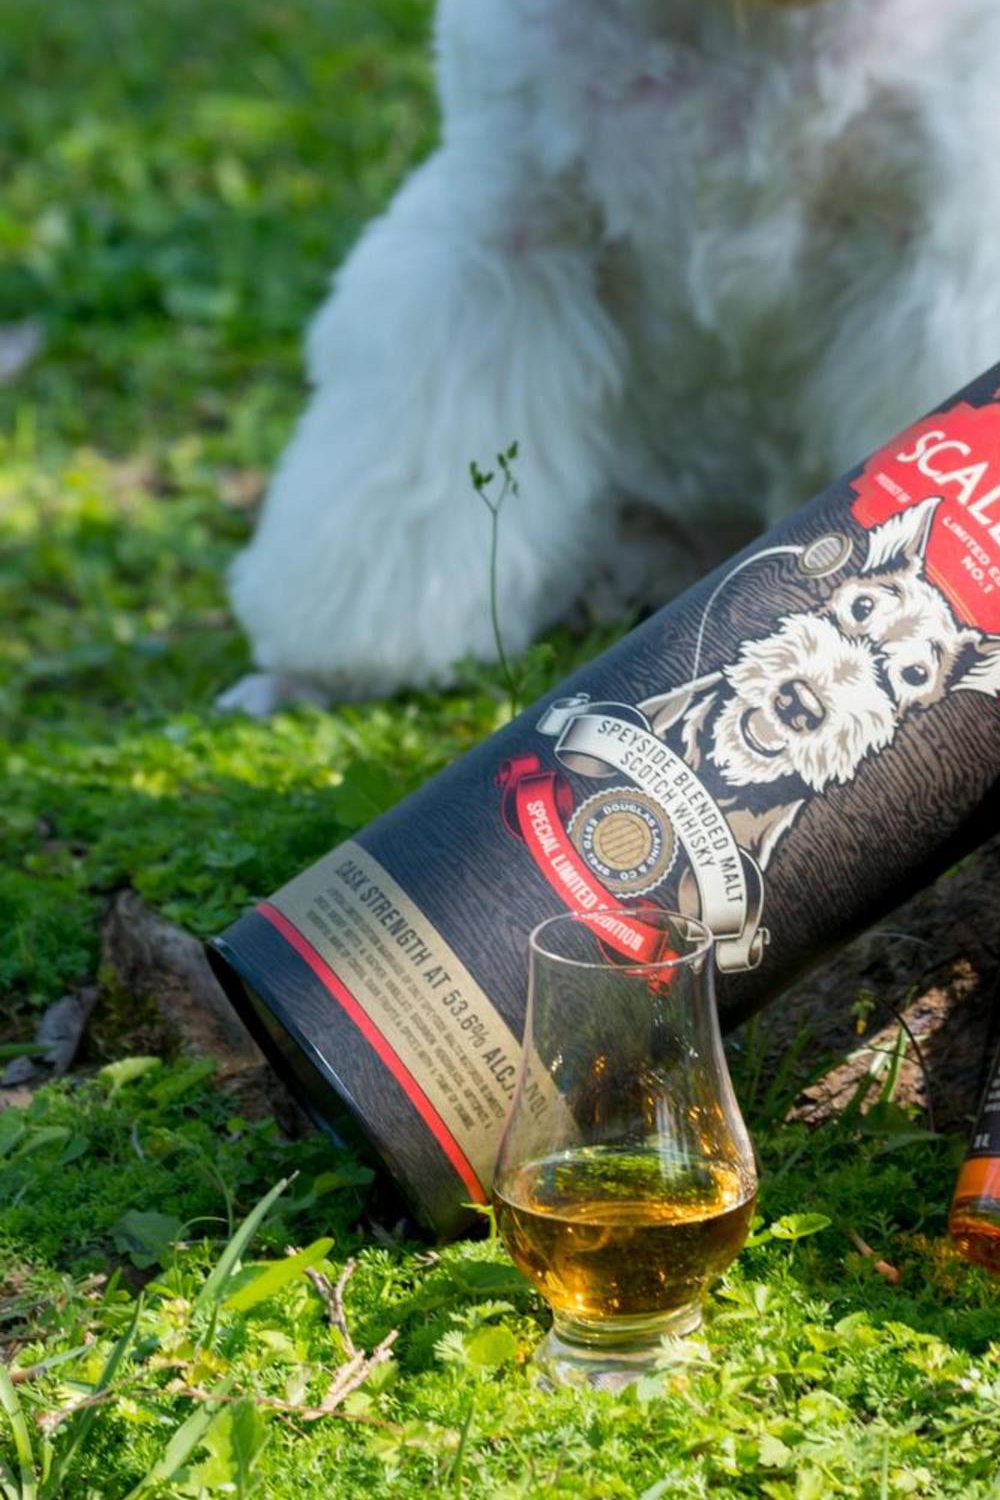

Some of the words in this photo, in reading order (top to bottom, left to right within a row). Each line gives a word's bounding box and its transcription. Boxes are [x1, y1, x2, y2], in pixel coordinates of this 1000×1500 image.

[942, 516, 991, 568] LIMITED
[960, 556, 994, 596] NO.1
[597, 719, 676, 773] SPEYSIDE
[673, 772, 729, 852] BLENDED
[719, 855, 744, 905] MALT
[602, 802, 656, 829] DOUGLAS
[620, 751, 673, 808] SCOTCH
[673, 805, 717, 870] WHISKY
[526, 800, 561, 855] SPECIAL
[551, 852, 599, 915] LIMITED
[619, 867, 638, 881] CO
[335, 860, 368, 893] CASK
[360, 886, 432, 968] STRENGTH
[423, 965, 452, 990] AT
[442, 986, 490, 1049] 53.6%
